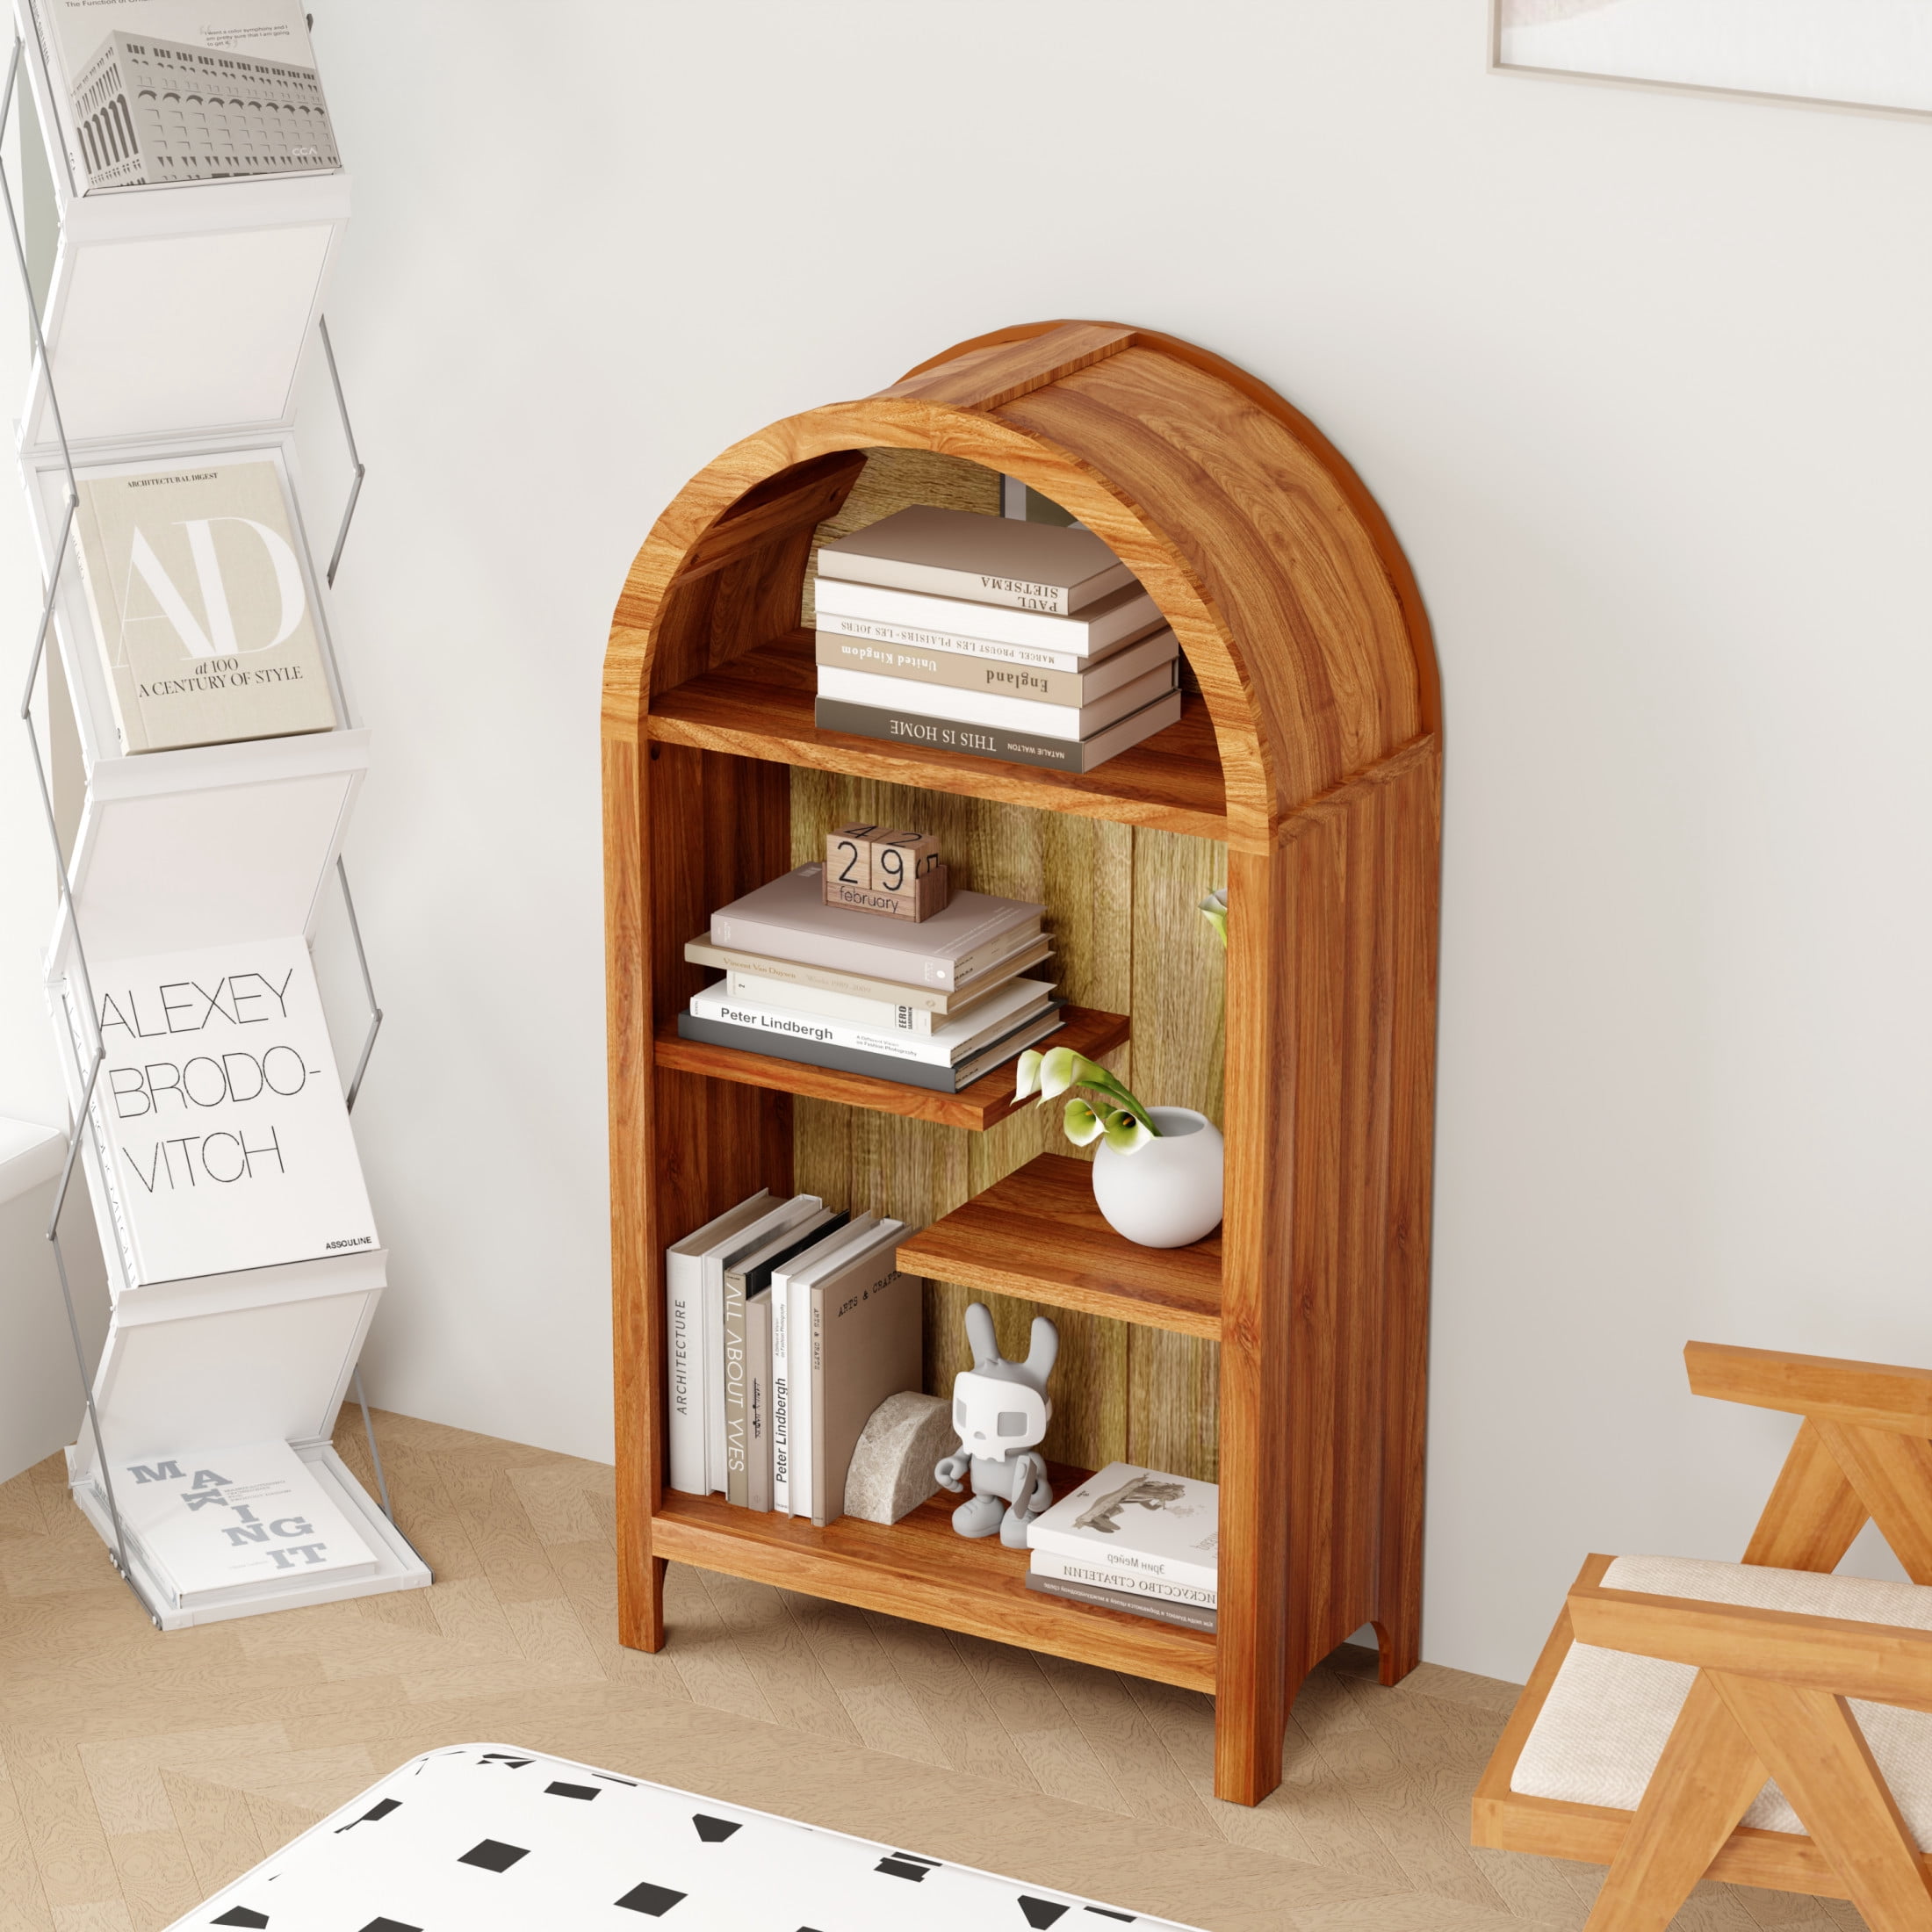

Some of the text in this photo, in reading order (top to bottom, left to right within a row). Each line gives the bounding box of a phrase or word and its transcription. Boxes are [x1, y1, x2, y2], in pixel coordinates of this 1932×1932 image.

[127, 472, 219, 488] ARCHITECTURAL DIGEST
[111, 516, 306, 669] AD
[981, 576, 1058, 599] SIETSEMA
[1017, 596, 1057, 612] PAUL
[840, 621, 872, 634] JOURS
[875, 626, 893, 638] LES
[955, 640, 977, 652] LES
[979, 644, 1015, 657] PROUST
[1018, 650, 1055, 664] MARCEL
[195, 657, 239, 675] at 100
[841, 645, 1049, 693] England United Kingdom
[139, 666, 303, 698] A CENTURY OF STYLE
[890, 719, 1065, 760] NATALIE WALTON THIS IS HOME
[839, 886, 899, 914] february
[723, 957, 751, 970] Vincent
[753, 962, 768, 973] Van
[768, 967, 797, 979] Duysen
[99, 968, 293, 1039] ALEXEY
[898, 1006, 907, 1029] EERO
[720, 1007, 758, 1025] Peter
[761, 1015, 833, 1041] Lindbergh
[864, 1041, 884, 1049] Fashion
[885, 1044, 918, 1057] Photography
[109, 1045, 321, 1119] BRODO-
[122, 1125, 285, 1193] VITCH
[325, 1236, 372, 1251] ASSOULINE
[725, 1282, 744, 1321] ALL
[838, 1270, 902, 1317] ARTS & CRAFTS
[674, 1299, 688, 1416] ARCHITECTURE
[726, 1327, 745, 1408] ABOUT
[775, 1377, 788, 1483] Peter Lindbergh
[728, 1417, 745, 1473] YVES
[266, 1542, 327, 1569] IT
